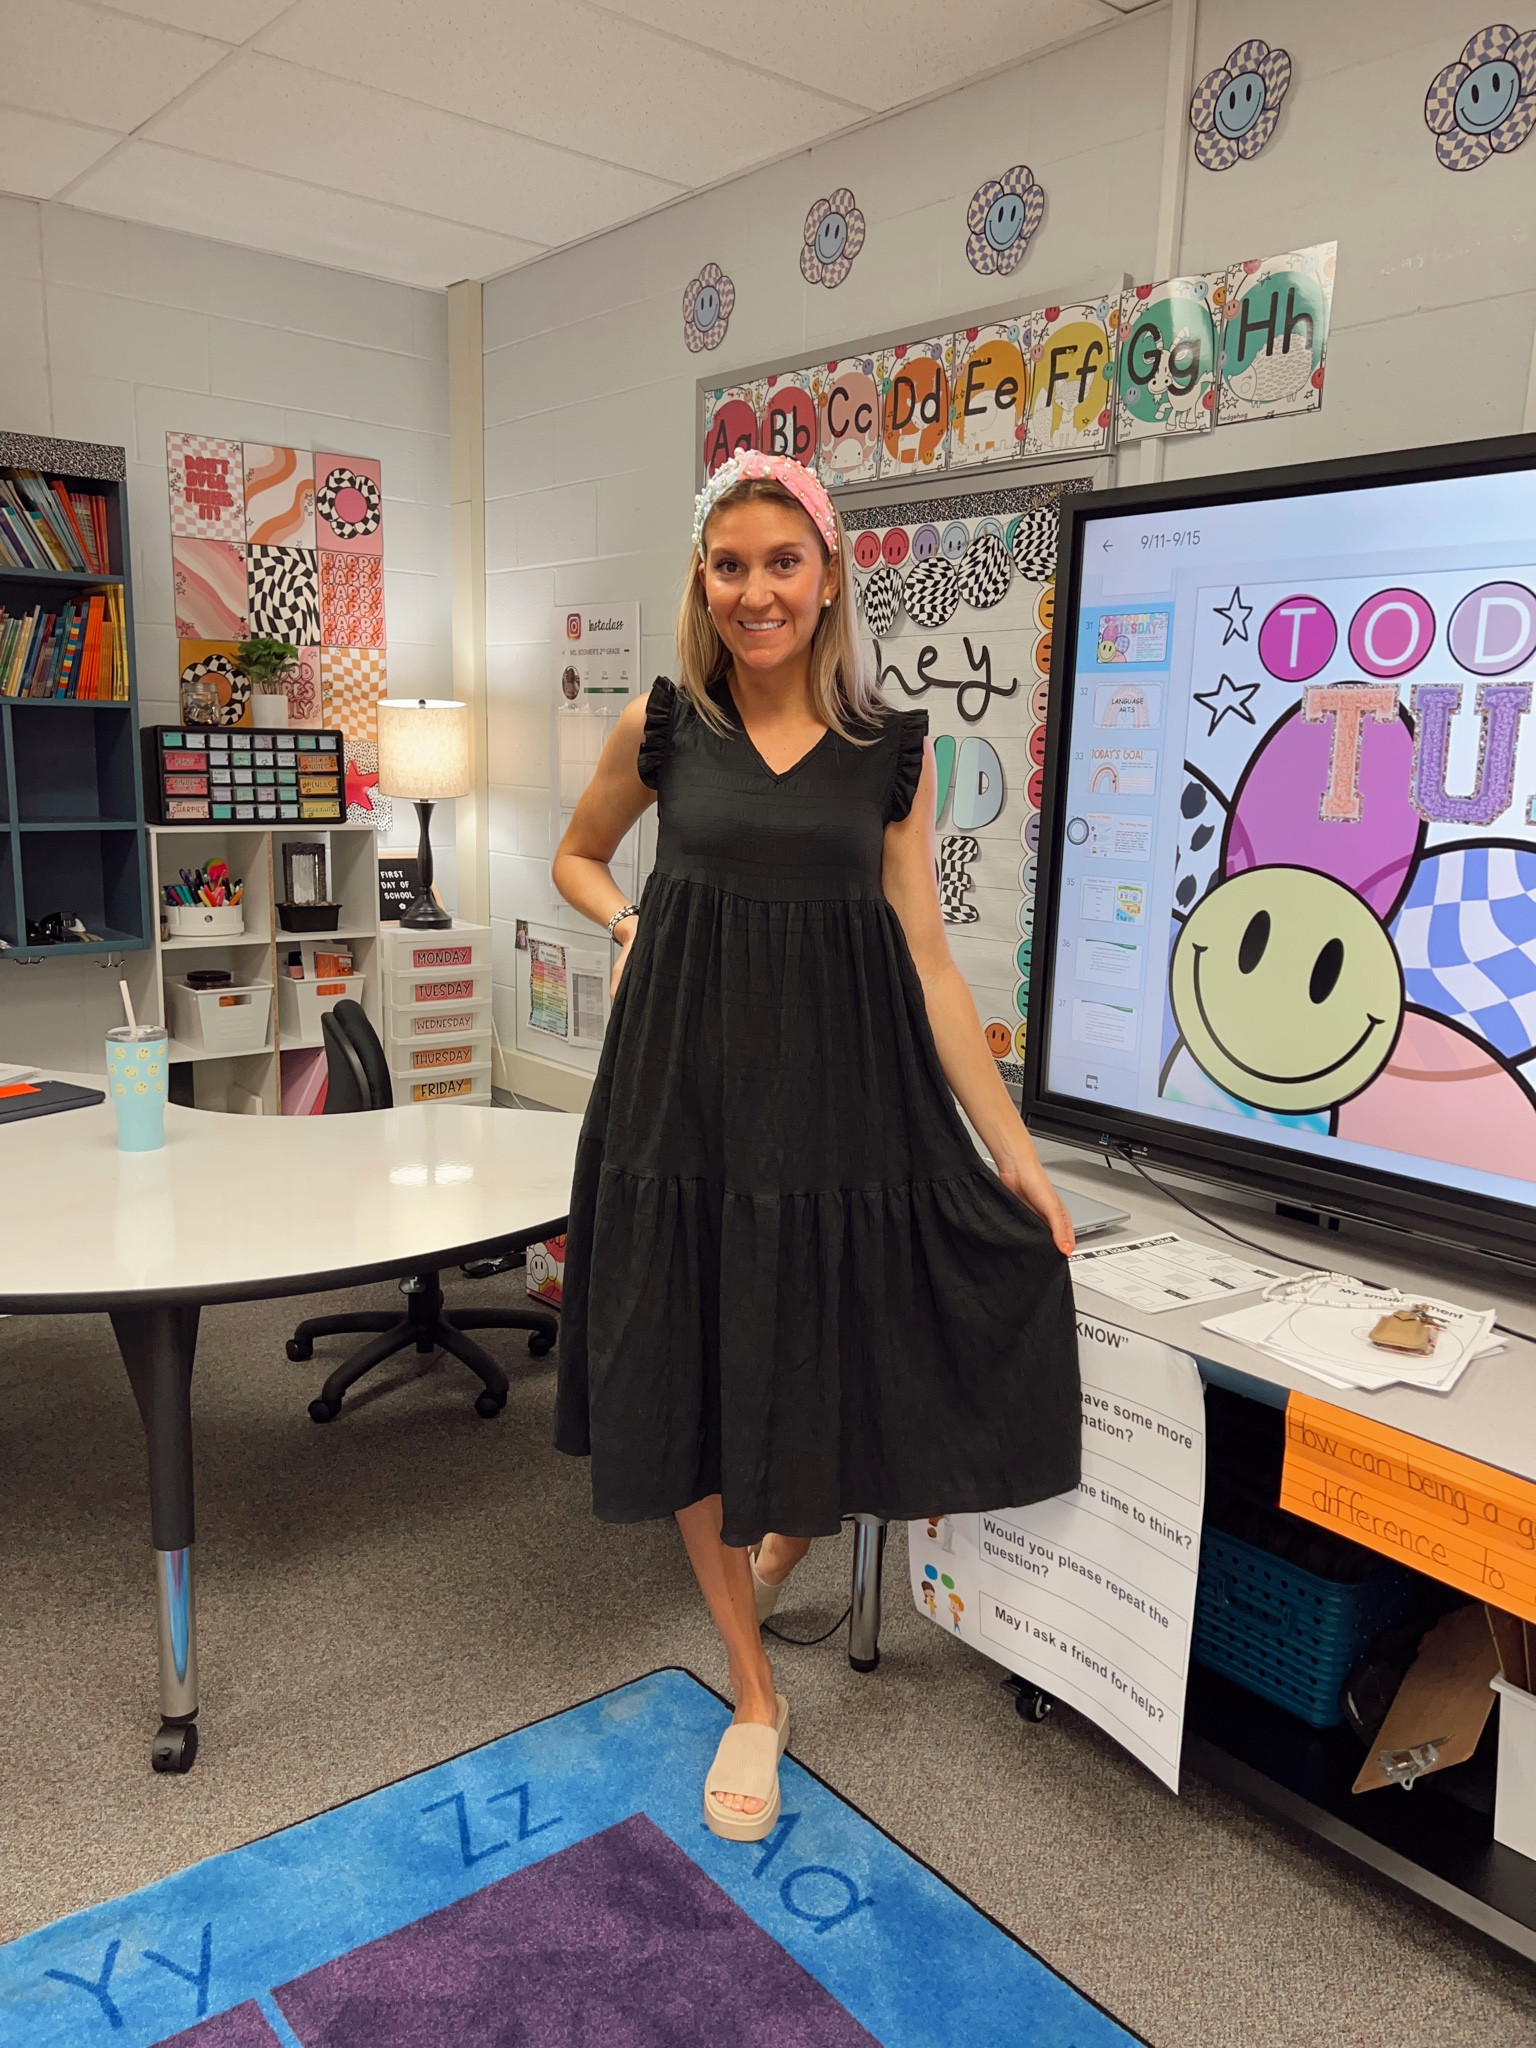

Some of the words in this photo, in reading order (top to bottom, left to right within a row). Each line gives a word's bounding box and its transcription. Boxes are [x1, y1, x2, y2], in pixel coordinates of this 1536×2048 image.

[1237, 286, 1314, 362] Hh
[1127, 322, 1201, 397] Gg
[1046, 340, 1103, 407] Ff
[964, 357, 1019, 416] Ee
[892, 367, 941, 430] Dd
[827, 387, 872, 438] Cc
[1219, 412, 1248, 421] hedgehog
[770, 405, 811, 455] Bb
[184, 455, 230, 475] DON'T
[185, 471, 229, 490] OVER
[1140, 530, 1200, 549] 9/11-9/15
[321, 552, 381, 570] HAPPY
[322, 567, 381, 586] HAPPY
[322, 583, 382, 602] HAPPY
[322, 599, 382, 617] HAPPY
[323, 614, 383, 633] HAPPY
[1086, 622, 1093, 630] 31
[324, 630, 384, 648] HAPPY
[872, 636, 1018, 721] hey
[1080, 688, 1088, 696] 32
[1111, 697, 1144, 706] LANGUAGE
[1076, 752, 1084, 760] 33
[1091, 749, 1120, 760] TODAY'S
[1302, 682, 1536, 827] TU
[173, 805, 206, 813] SHARPIES
[380, 870, 404, 879] FIRST
[1066, 878, 1074, 886] 35
[381, 881, 396, 889] DAY
[400, 880, 410, 888] OF
[384, 891, 415, 899] SCHOOL
[1062, 939, 1070, 948] 36
[417, 950, 468, 965] MONDAY
[418, 983, 471, 997] TUESDAY
[416, 1016, 471, 1030] WEDNESDAY
[415, 1050, 469, 1065] THURSDAY
[421, 1079, 464, 1097] FRIDAY
[1339, 1288, 1360, 1296] My
[1113, 1404, 1153, 1430] some
[1157, 1422, 1193, 1449] more
[1287, 1406, 1338, 1457] How
[1350, 1448, 1392, 1480] can
[1406, 1453, 1469, 1525] being
[1483, 1502, 1501, 1524] a
[1101, 1489, 1129, 1514] time
[1133, 1506, 1146, 1524] to
[1150, 1516, 1193, 1550] think?
[1311, 1478, 1449, 1566] difference
[1472, 1547, 1506, 1590] to
[983, 1540, 1050, 1579] question?
[983, 1517, 1025, 1548] Would
[1028, 1540, 1054, 1562] you
[1058, 1550, 1102, 1585] please
[1106, 1576, 1147, 1614] repeat
[1149, 1603, 1169, 1629] the
[995, 1605, 1022, 1631] May
[1024, 1620, 1029, 1634] I
[1033, 1625, 1057, 1649] ask
[1060, 1641, 1068, 1654] a
[1071, 1644, 1108, 1679] friend
[1111, 1670, 1128, 1694] for
[1131, 1686, 1165, 1723] help?
[420, 1781, 563, 1869] Zz
[44, 1921, 216, 2029] Yy
